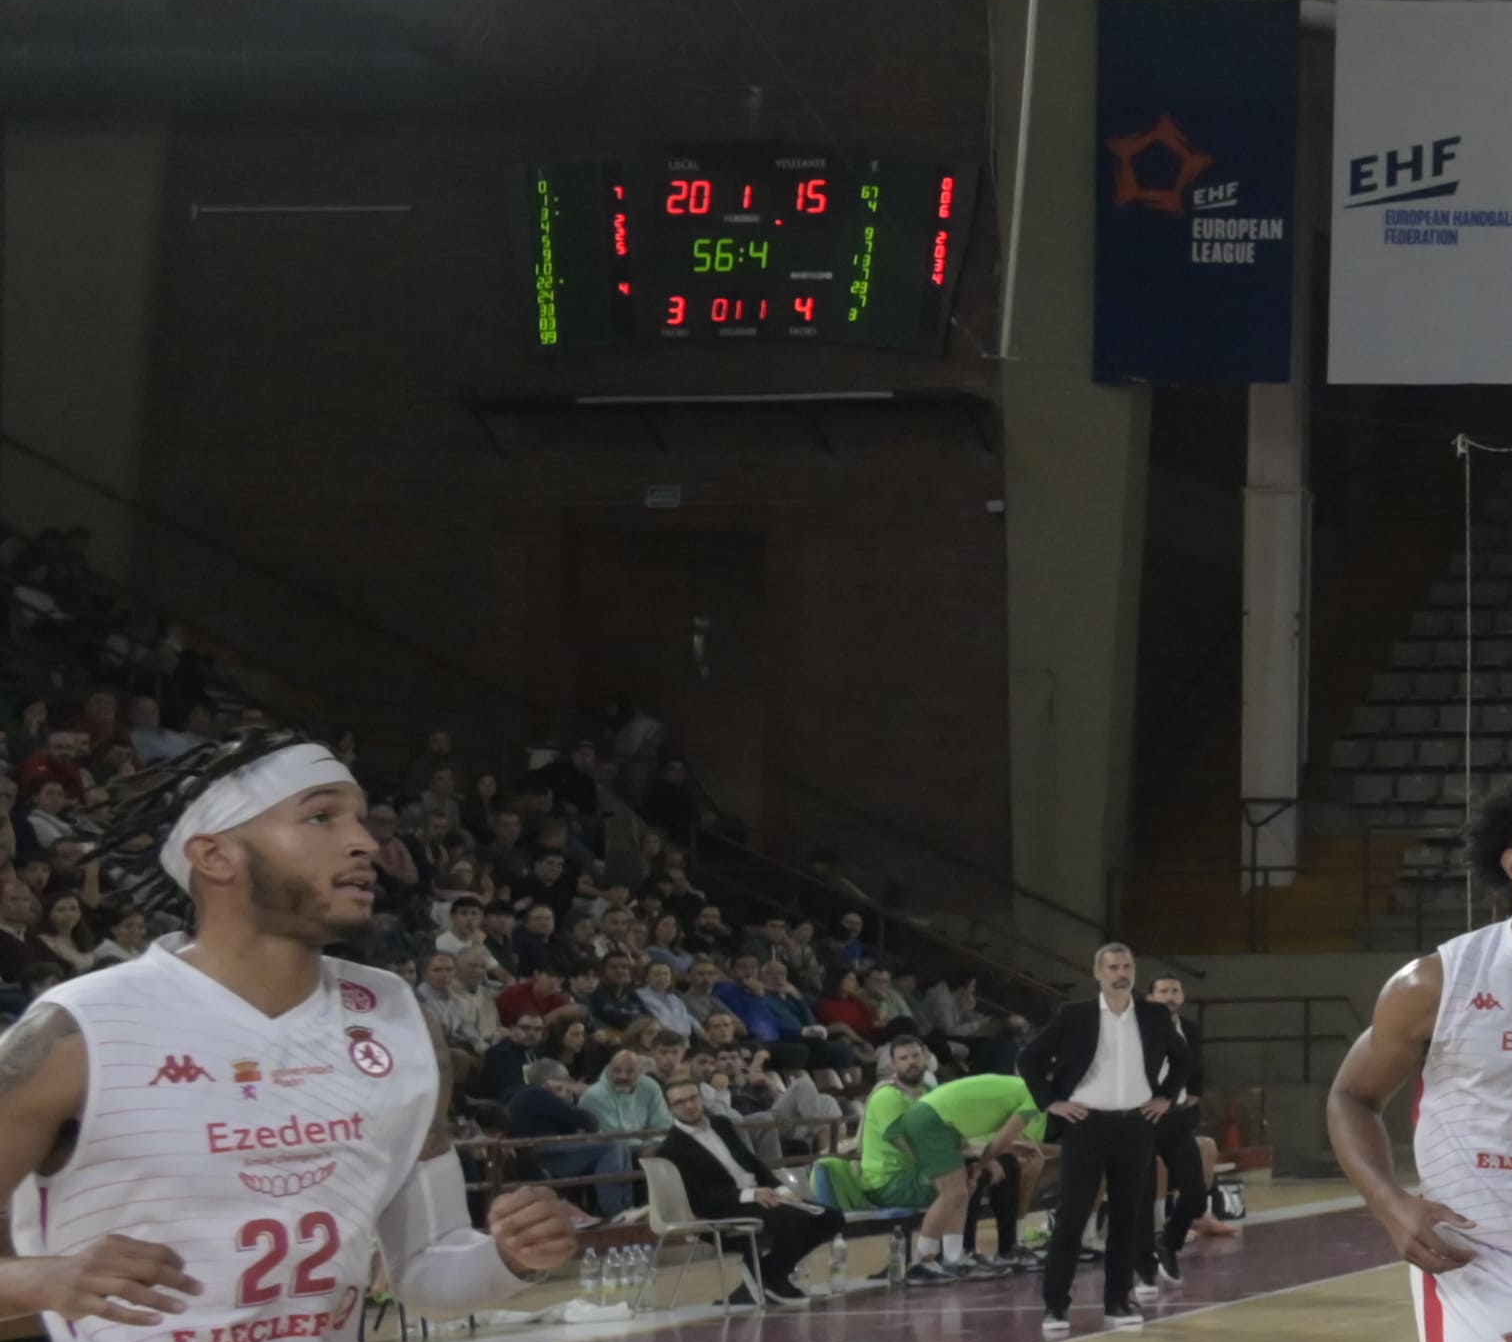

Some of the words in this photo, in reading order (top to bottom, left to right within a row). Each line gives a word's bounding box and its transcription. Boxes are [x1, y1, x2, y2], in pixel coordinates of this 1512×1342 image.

[1349, 136, 1461, 197] EHF
[665, 179, 713, 215] 20
[795, 179, 828, 214] 15
[1193, 182, 1239, 205] EHF
[1192, 218, 1283, 240] EUROPEAN
[1384, 211, 1450, 227] EUROPEAN
[1384, 229, 1459, 245] FEDERATION
[692, 238, 769, 273] 56:4
[1192, 242, 1255, 264] LEAGUE
[666, 295, 687, 326] 3
[793, 297, 815, 322] 4
[207, 1112, 364, 1154] Ezedent
[236, 1211, 341, 1307] 22
